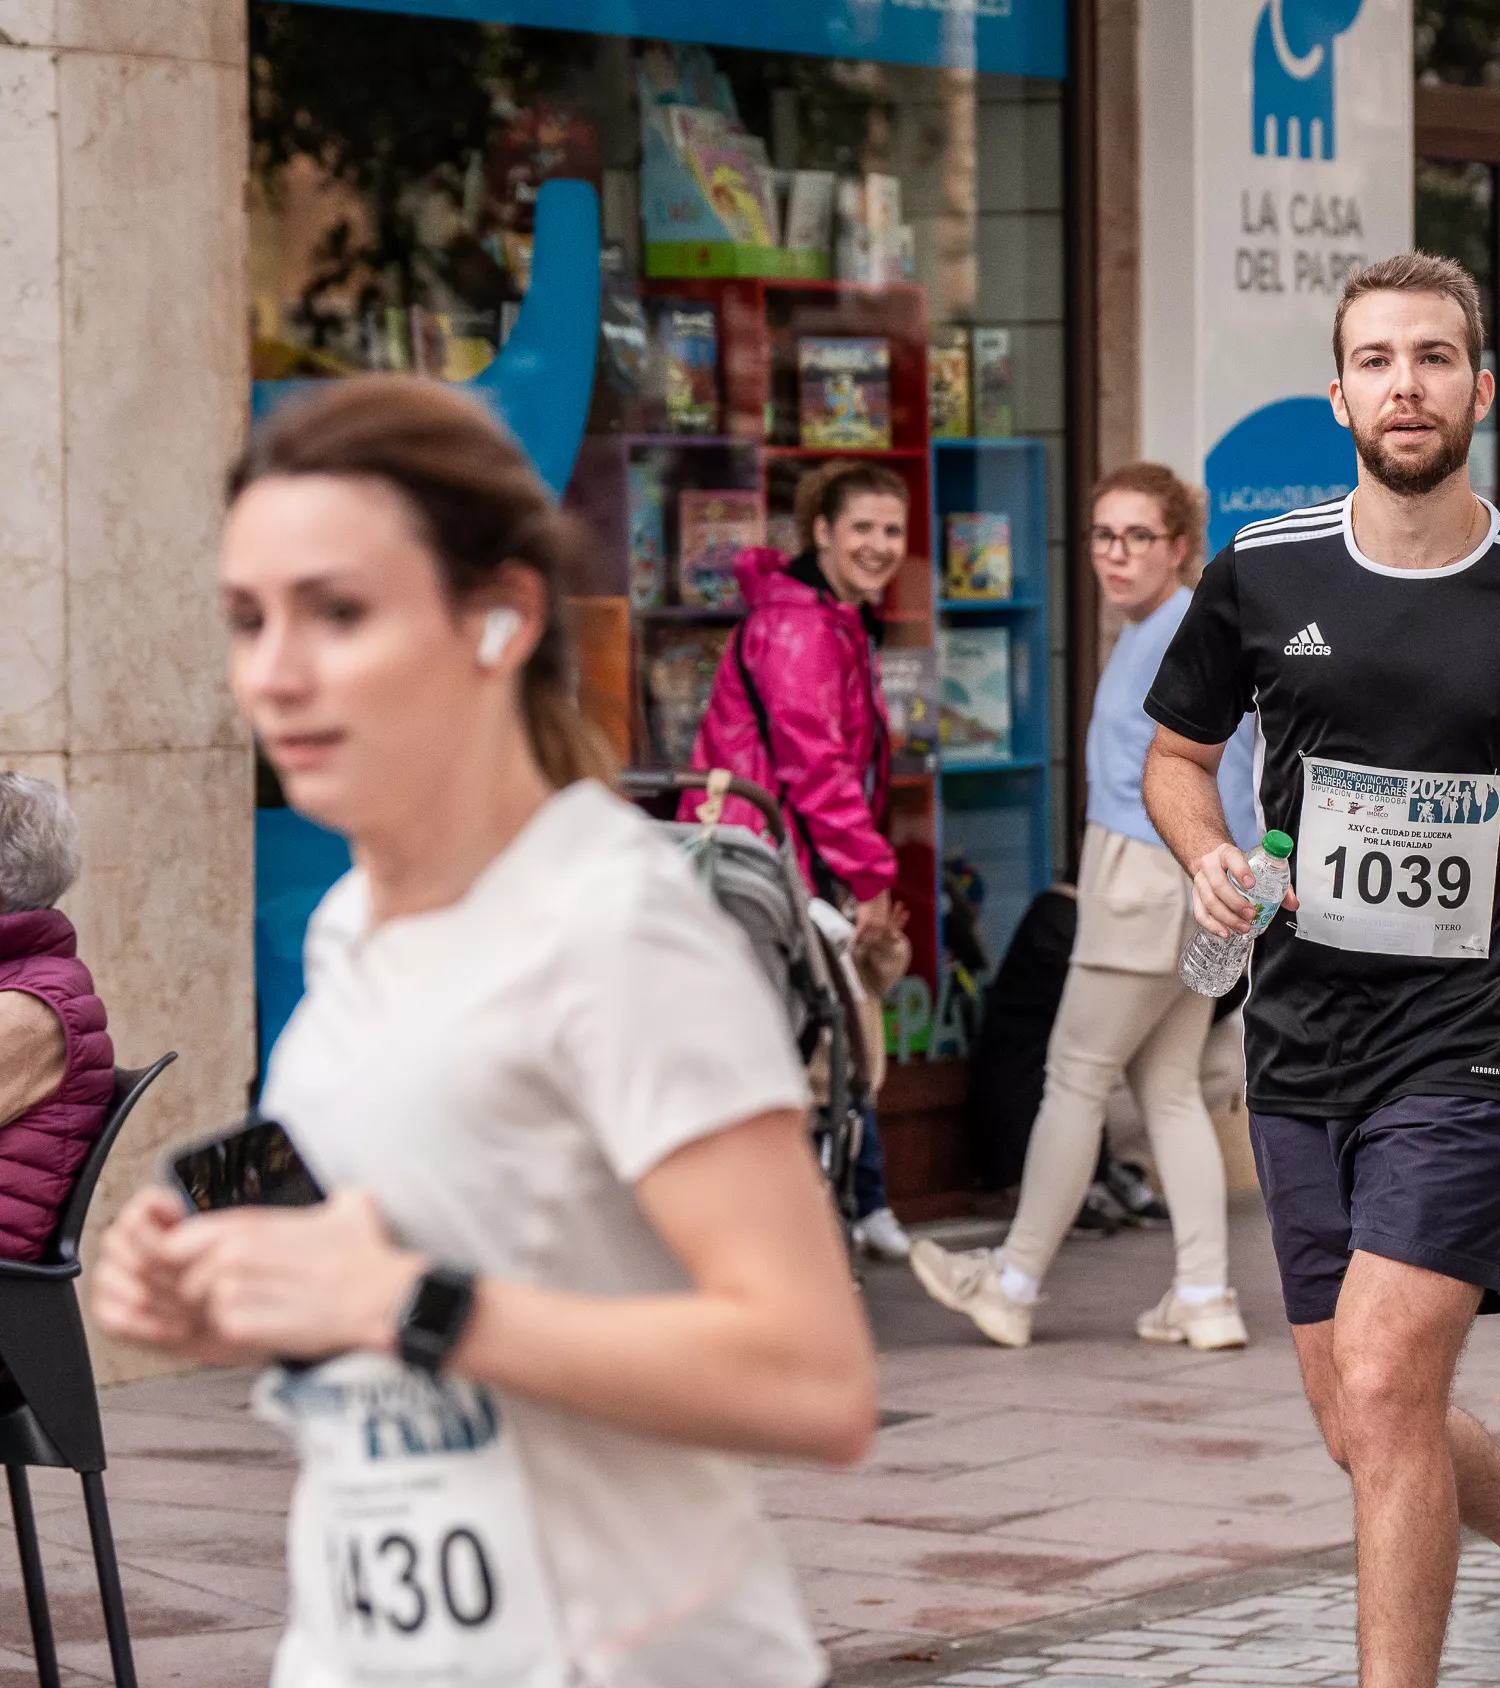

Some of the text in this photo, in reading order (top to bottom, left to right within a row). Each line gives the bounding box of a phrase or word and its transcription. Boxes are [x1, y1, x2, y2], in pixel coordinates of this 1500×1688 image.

[1240, 188, 1363, 238] LA CASA
[1235, 247, 1285, 292] DEL
[1283, 643, 1332, 656] adidas
[1311, 764, 1408, 788] CIRCUITO PROVINCIAL DE
[1311, 774, 1408, 797] CARRERAS POPULARES
[1311, 784, 1407, 805] DIPUTACIÓN DE CÓRDOBA
[1409, 778, 1462, 800] 2024
[1348, 823, 1452, 840] XXV C.P. CIUDAD DE LUCENA
[1363, 837, 1433, 849] POR LA IGUALDAD
[1324, 845, 1471, 909] 1039
